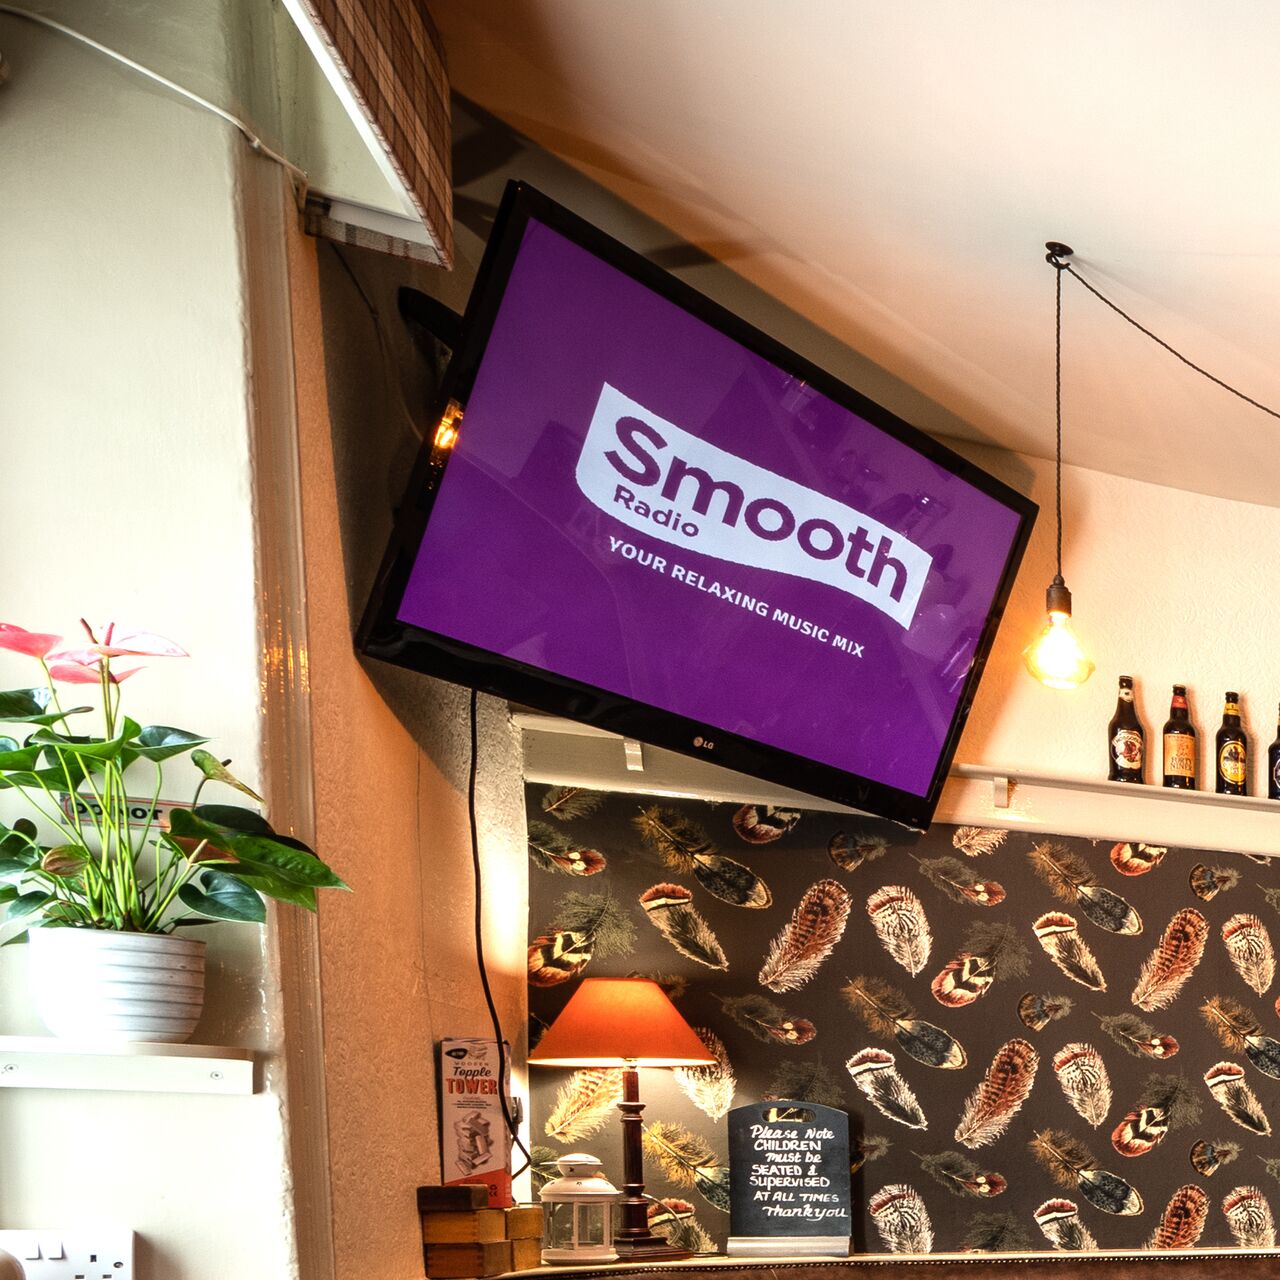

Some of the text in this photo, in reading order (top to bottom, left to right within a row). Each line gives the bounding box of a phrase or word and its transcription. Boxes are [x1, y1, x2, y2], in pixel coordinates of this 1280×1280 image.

[604, 416, 908, 603] Smooth
[614, 484, 699, 537] Radio
[608, 535, 865, 658] YOUR RELAXING MUSIC MIX
[703, 740, 714, 750] LG
[453, 1066, 492, 1080] Topple
[446, 1078, 498, 1095] TOWER
[750, 1124, 835, 1139] Please Note
[754, 1140, 822, 1151] CHILDREN
[765, 1151, 822, 1163] must be
[751, 1164, 802, 1175] SEATED
[749, 1176, 830, 1191] SUPERVISED
[753, 1190, 839, 1202] AT ALL TIMES
